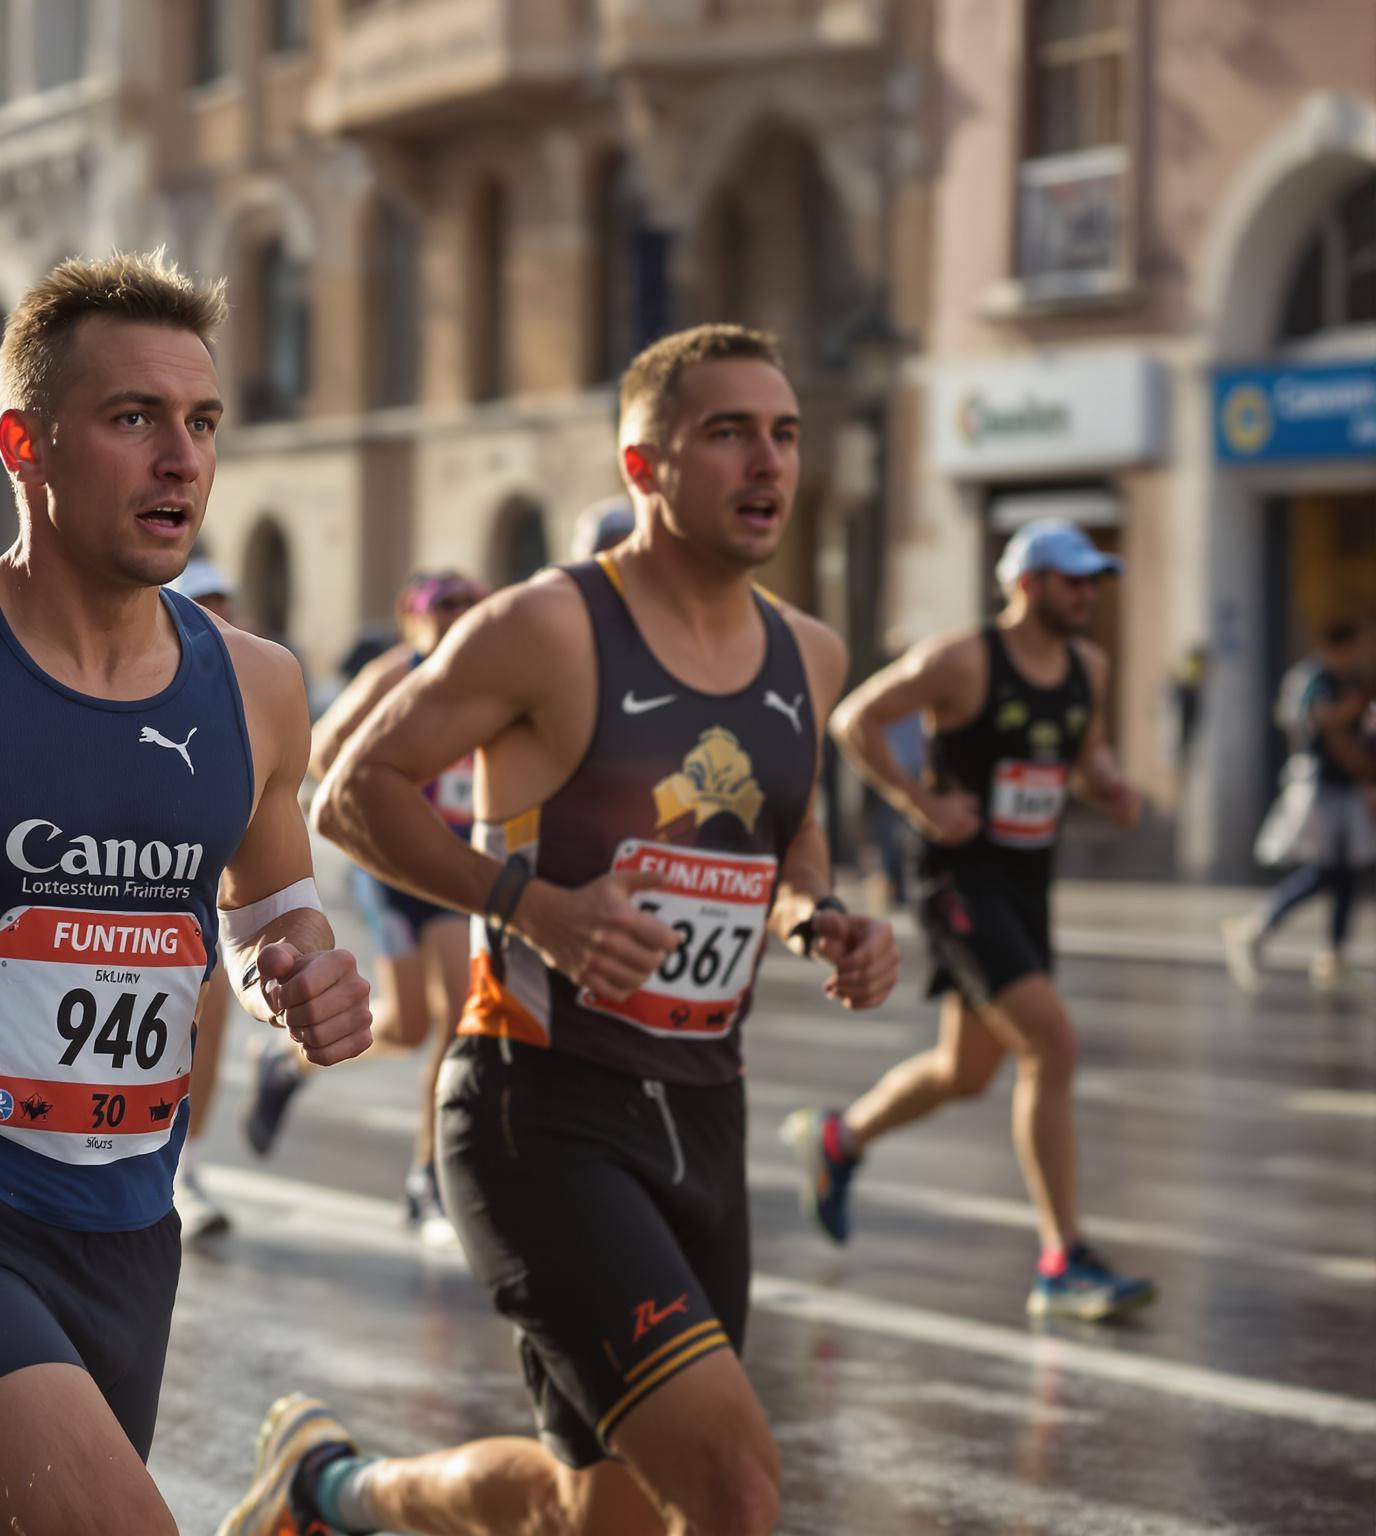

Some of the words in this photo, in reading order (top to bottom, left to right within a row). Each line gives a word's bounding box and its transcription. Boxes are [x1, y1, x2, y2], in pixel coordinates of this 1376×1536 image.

[5, 819, 205, 881] Canon
[53, 922, 180, 955] FUNTING
[56, 988, 168, 1070] 946
[91, 1093, 126, 1129] 30
